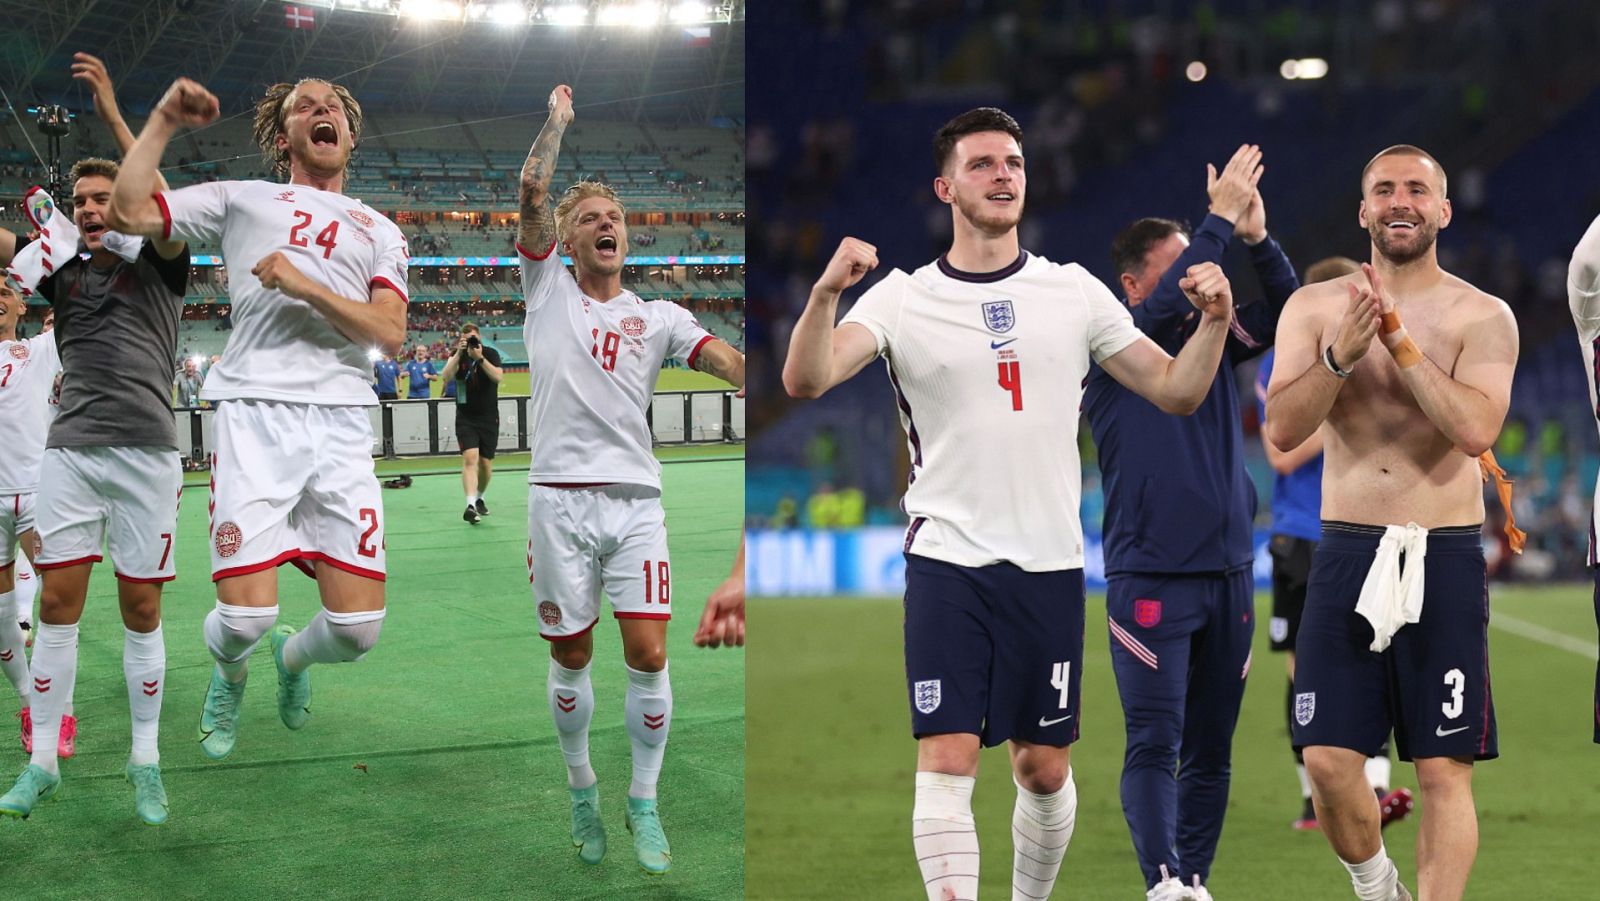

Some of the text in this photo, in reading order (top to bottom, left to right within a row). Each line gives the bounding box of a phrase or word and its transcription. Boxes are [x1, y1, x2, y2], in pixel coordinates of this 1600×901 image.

[289, 210, 339, 260] 24
[591, 328, 620, 373] 18
[997, 361, 1023, 412] 4
[158, 533, 171, 571] 7
[643, 560, 670, 605] 18
[1050, 661, 1071, 709] 4
[1442, 668, 1465, 719] 3
